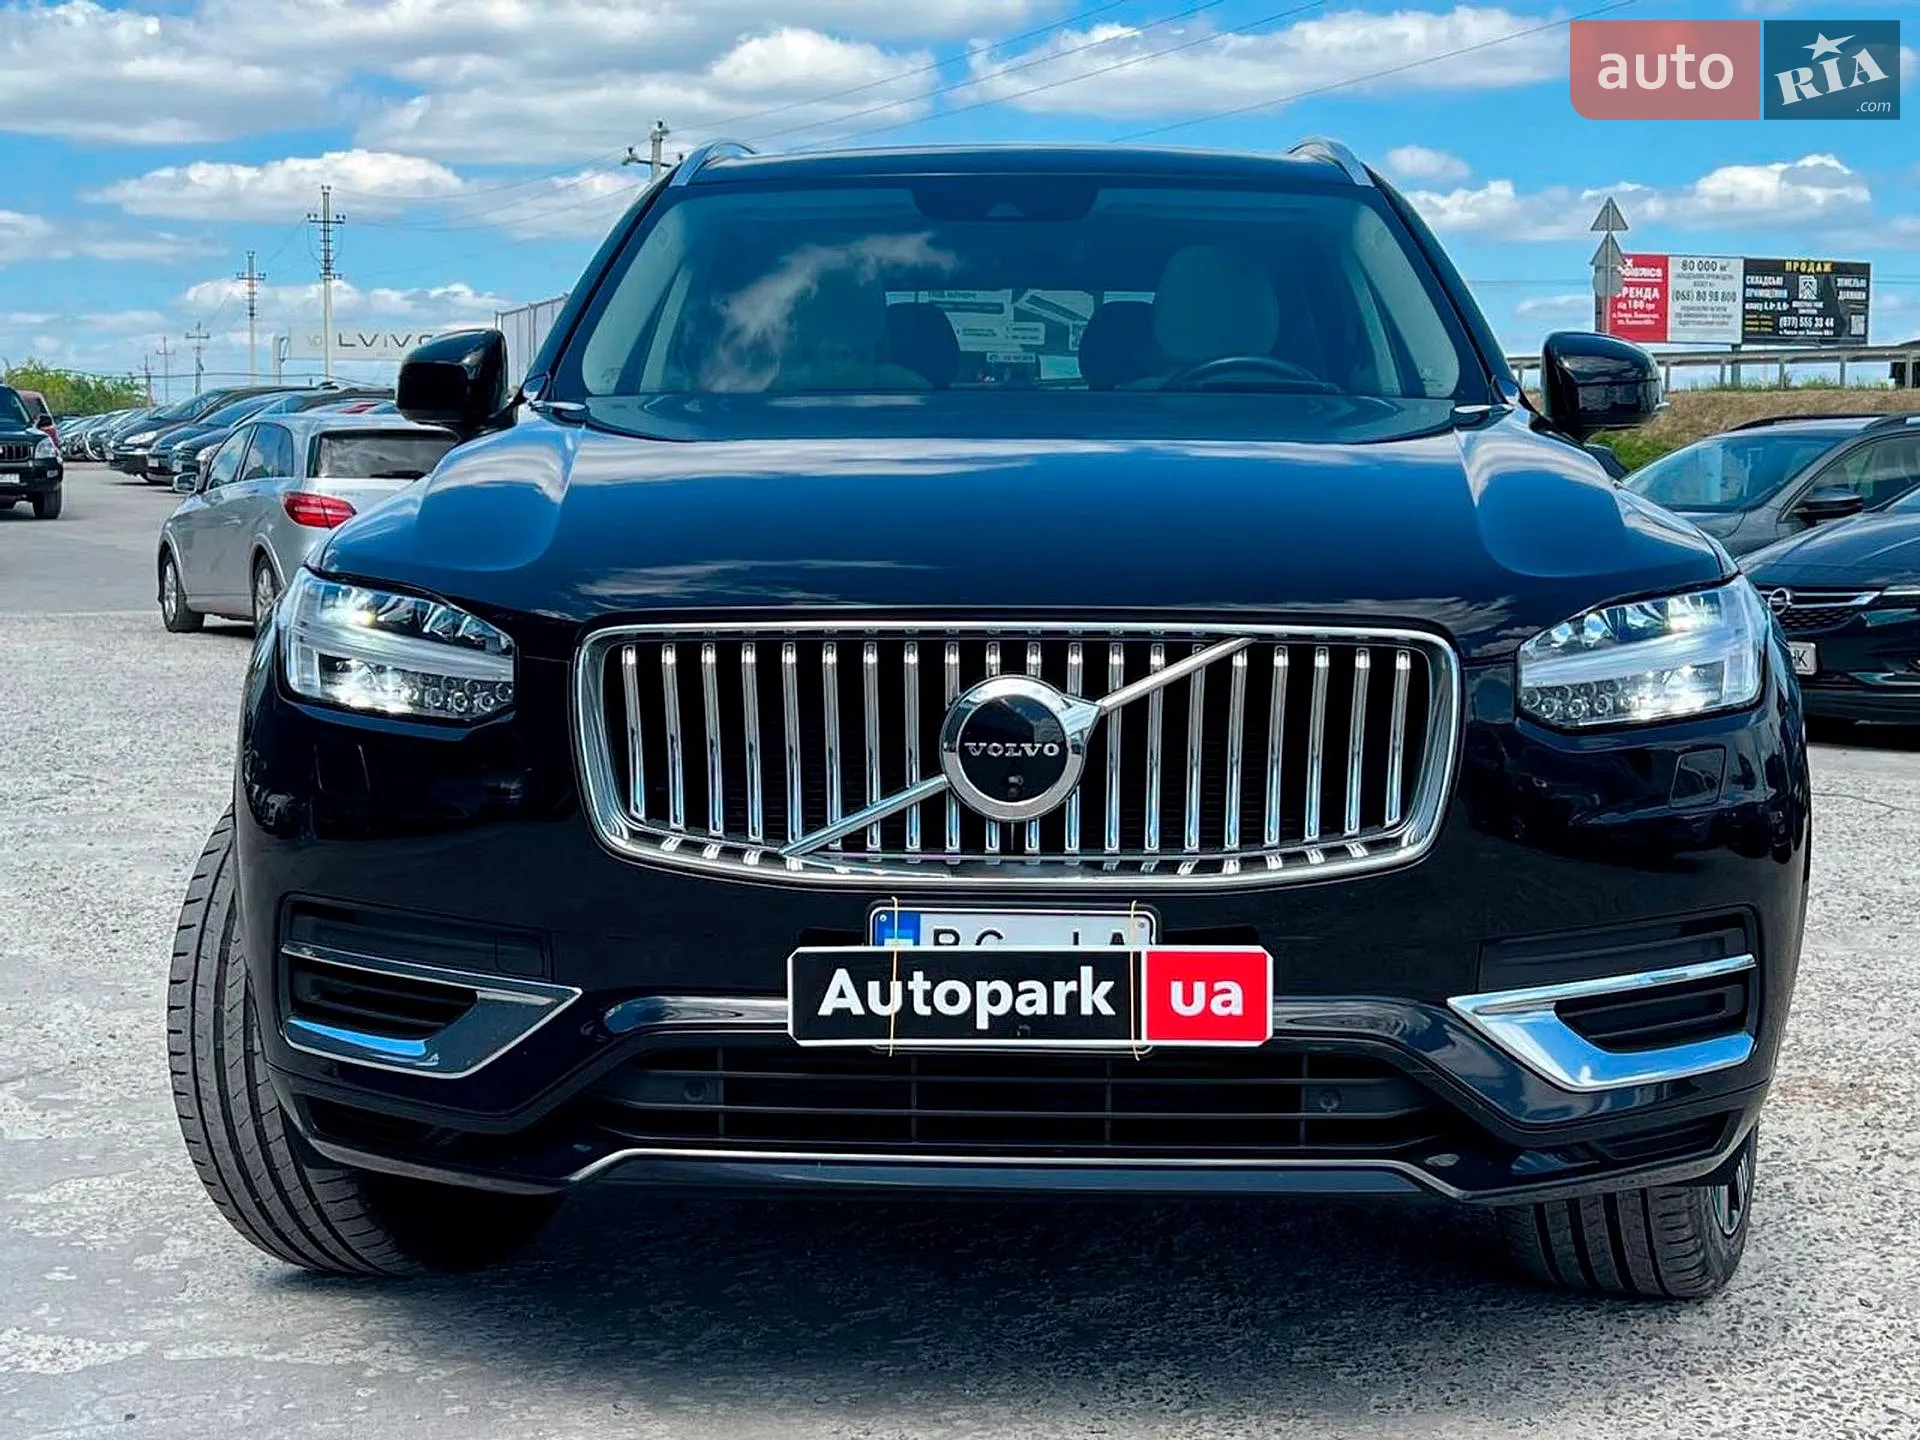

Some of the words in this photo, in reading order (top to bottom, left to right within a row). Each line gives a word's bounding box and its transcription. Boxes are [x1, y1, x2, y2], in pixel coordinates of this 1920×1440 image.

[1784, 261, 1833, 273] ПРОДАЖ
[1615, 286, 1660, 301] РЕНДА
[964, 742, 1060, 757] VOLVO
[817, 965, 1116, 1031] Autopark
[1169, 980, 1246, 1017] ua
